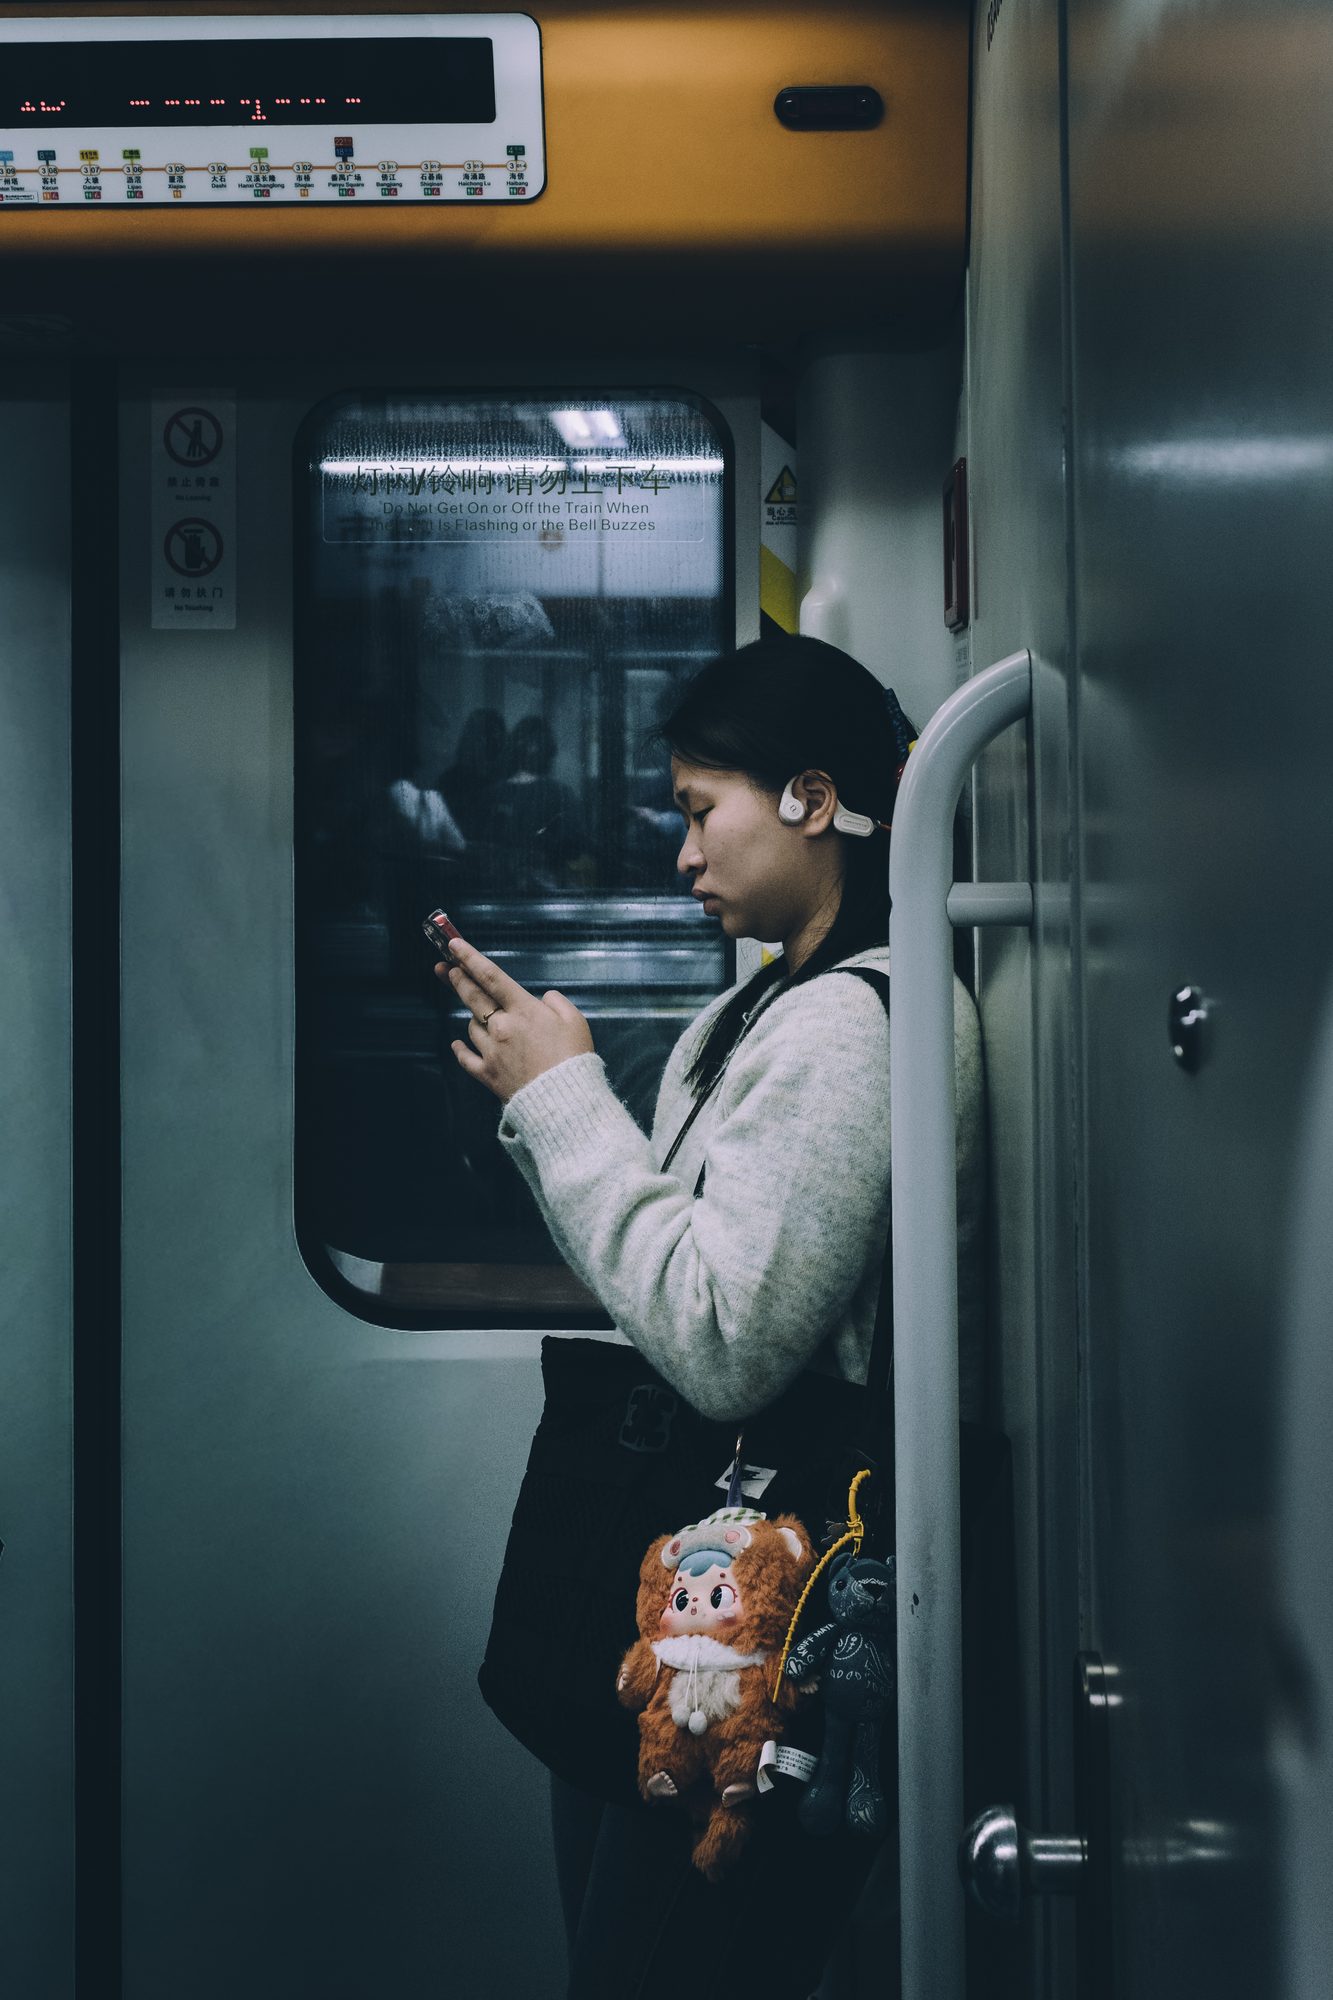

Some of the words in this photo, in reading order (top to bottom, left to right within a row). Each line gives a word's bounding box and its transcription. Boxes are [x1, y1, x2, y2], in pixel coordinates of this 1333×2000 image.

[352, 464, 492, 496] 灯闪/铃响
[506, 464, 670, 496] 请勿上下车
[383, 502, 403, 514] Do
[408, 502, 432, 514] Not
[438, 502, 463, 514] Get
[468, 502, 488, 514] On
[493, 504, 507, 514] or
[512, 502, 534, 514] Off
[538, 502, 560, 514] the
[565, 502, 602, 514] Train
[606, 502, 649, 514] When
[438, 519, 450, 531] Is
[455, 519, 518, 533] Flashing
[522, 522, 537, 531] or
[542, 519, 564, 531] the
[569, 519, 596, 531] Bell
[601, 519, 656, 531] Buzzes
